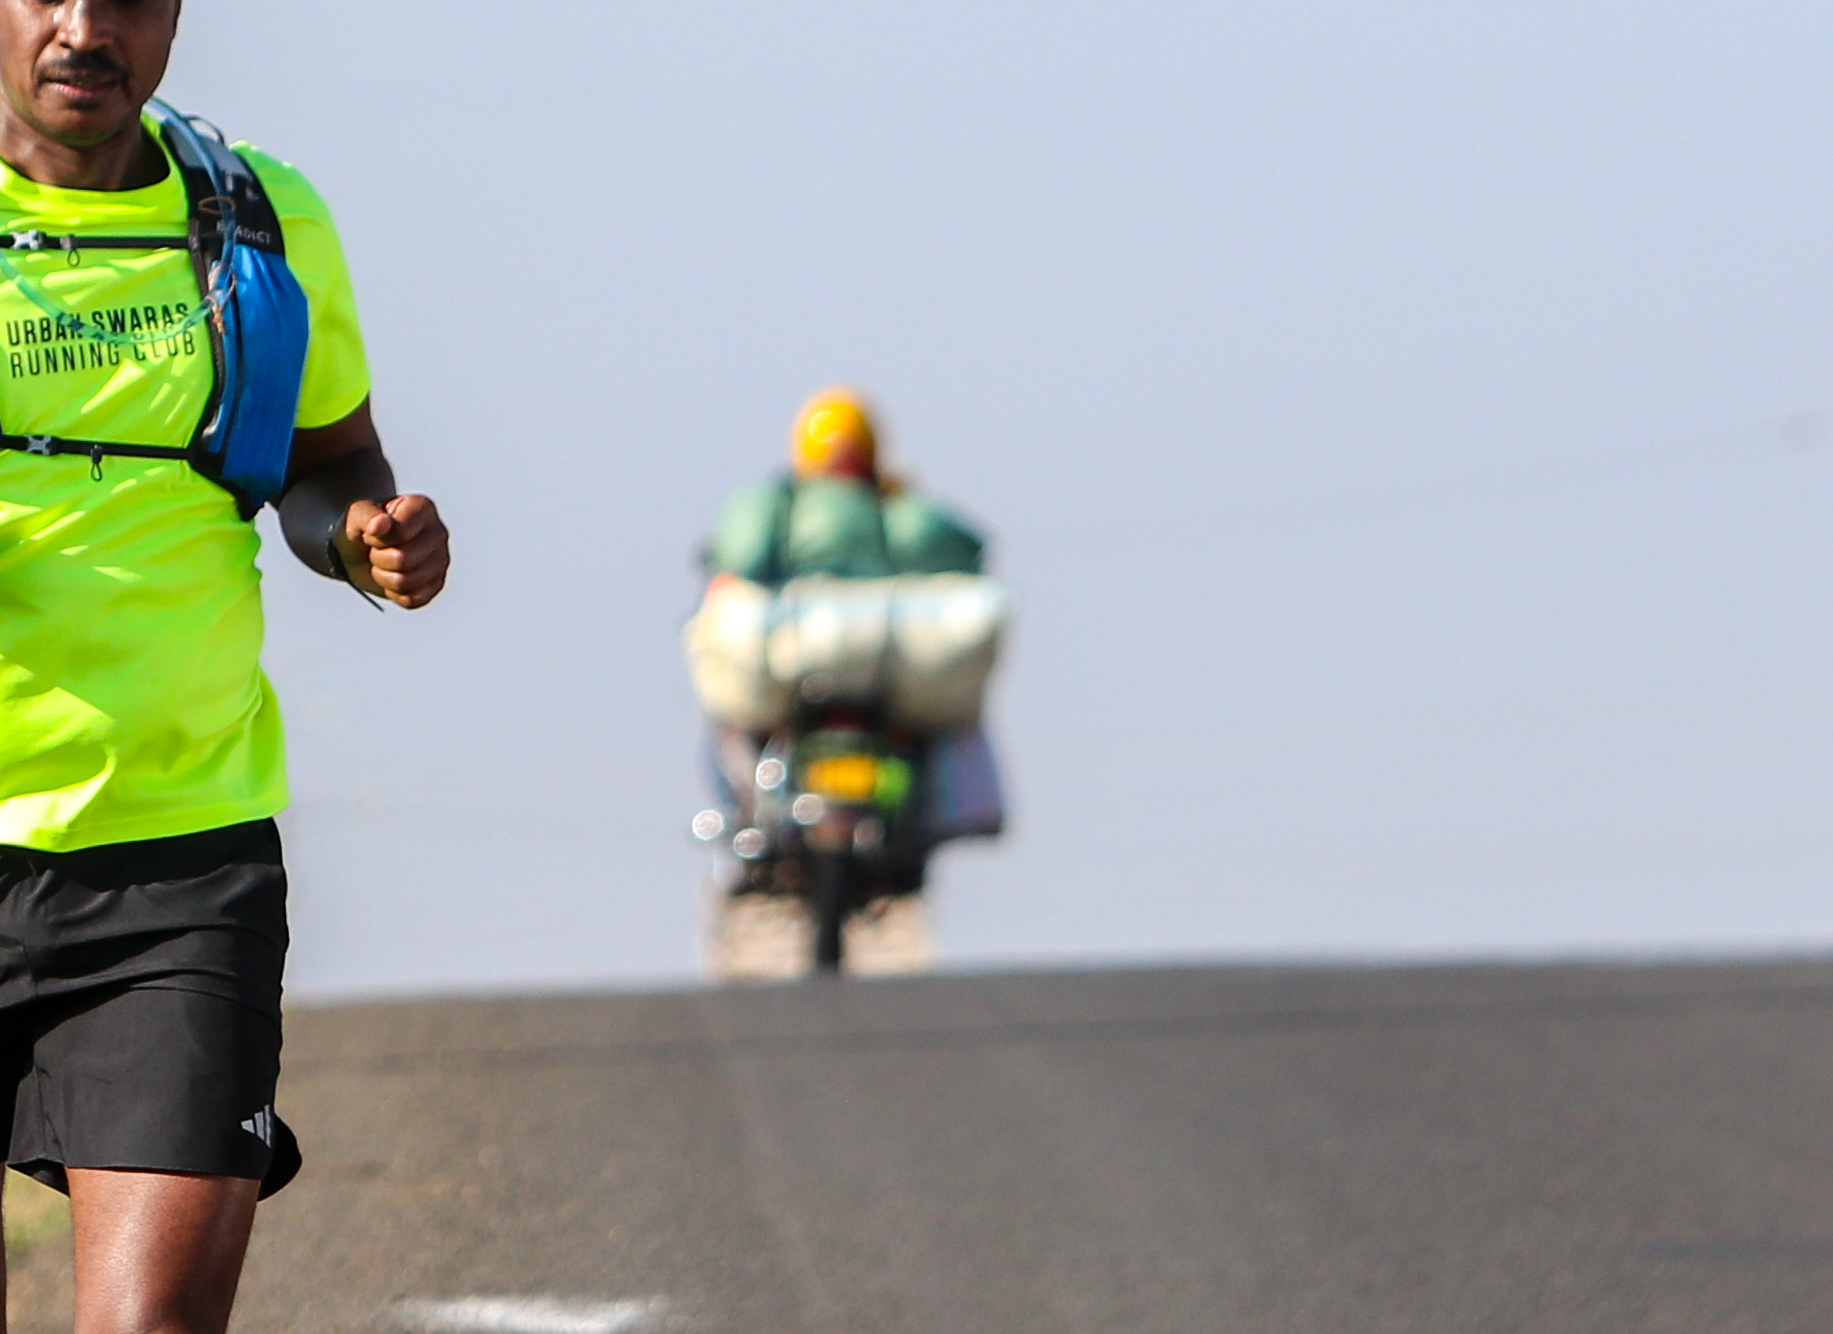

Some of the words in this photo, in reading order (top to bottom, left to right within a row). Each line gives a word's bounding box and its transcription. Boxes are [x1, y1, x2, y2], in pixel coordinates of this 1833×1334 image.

[91, 302, 188, 334] SWARAS
[10, 341, 120, 379] RUNNING
[133, 330, 195, 362] CLUB
